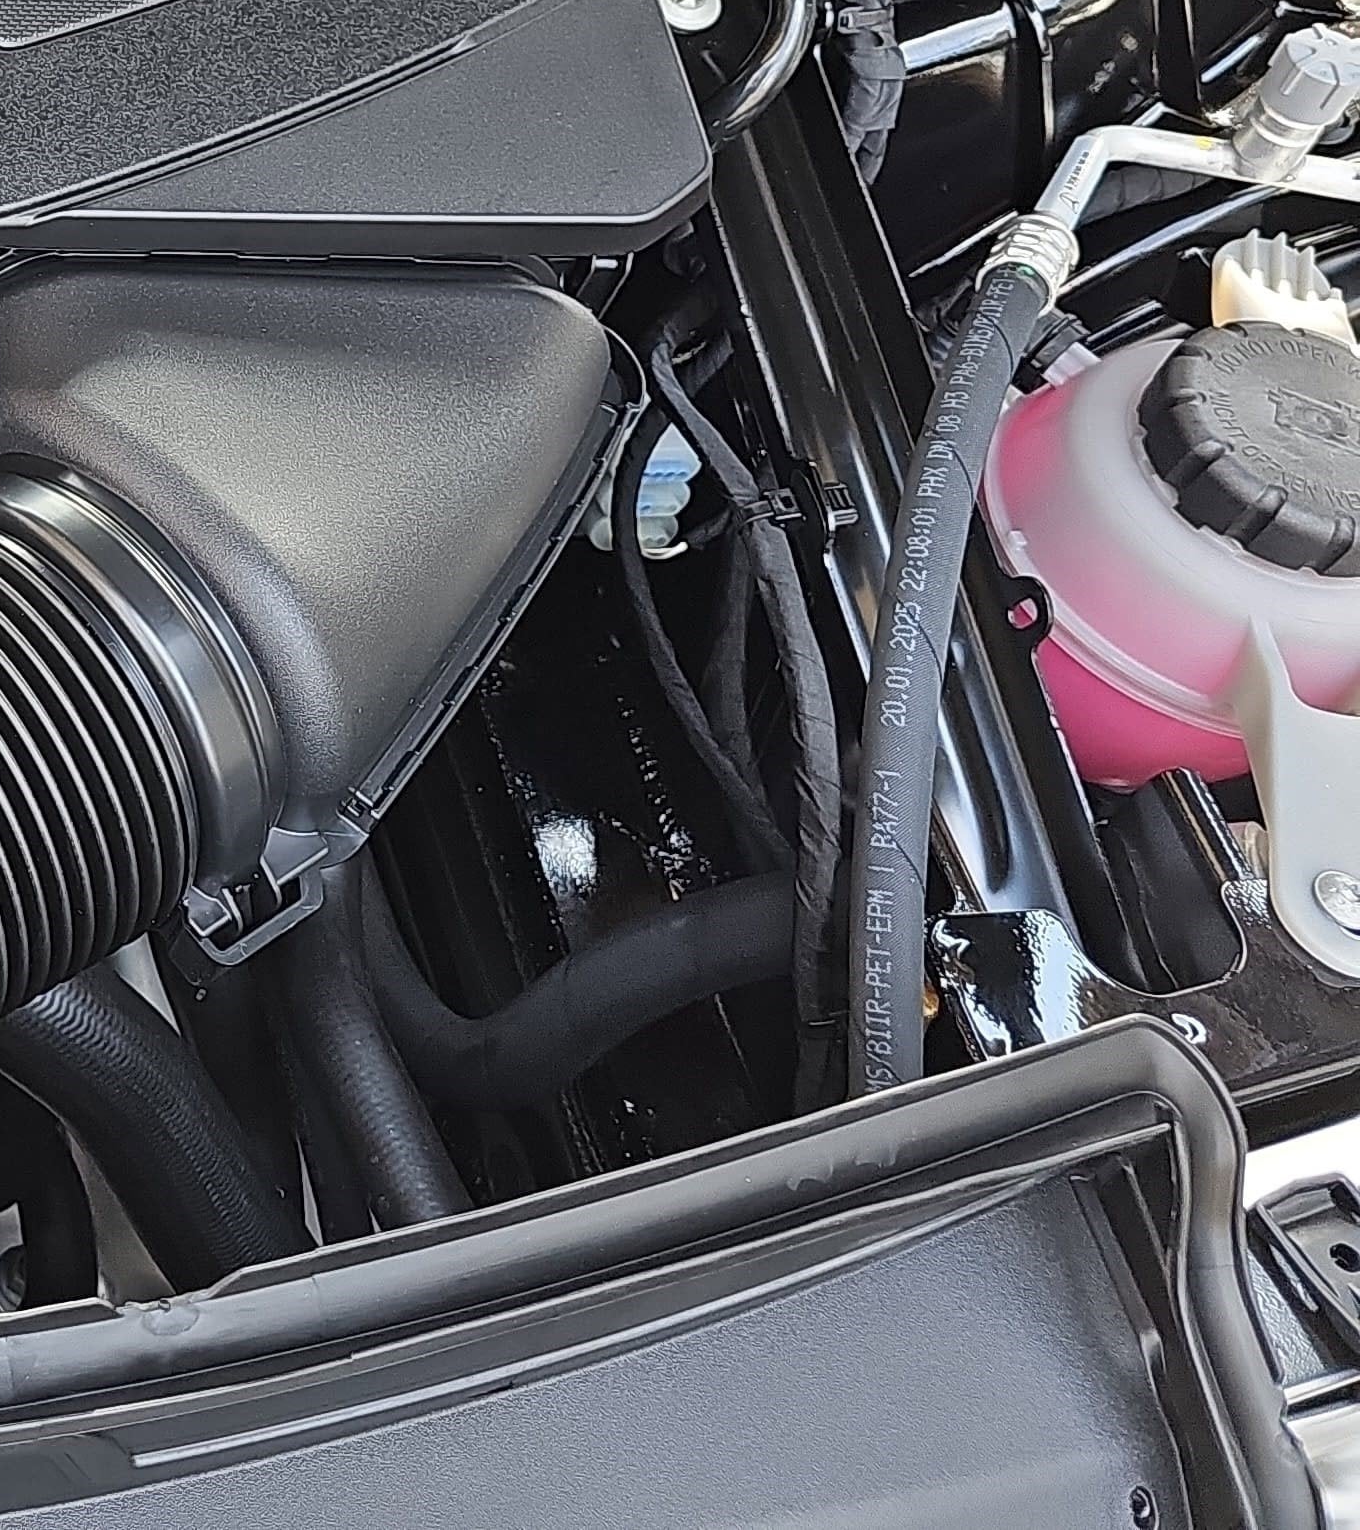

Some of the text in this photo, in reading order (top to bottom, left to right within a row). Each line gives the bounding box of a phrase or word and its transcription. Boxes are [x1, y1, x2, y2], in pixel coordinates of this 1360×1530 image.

[1233, 340, 1275, 363] NOT
[1280, 339, 1337, 367] OPEN
[941, 390, 971, 411] H3
[1208, 388, 1250, 440] NICHT
[917, 465, 948, 499] PHX
[900, 506, 937, 592] 22:08:01
[880, 601, 921, 728] 20.01.2025
